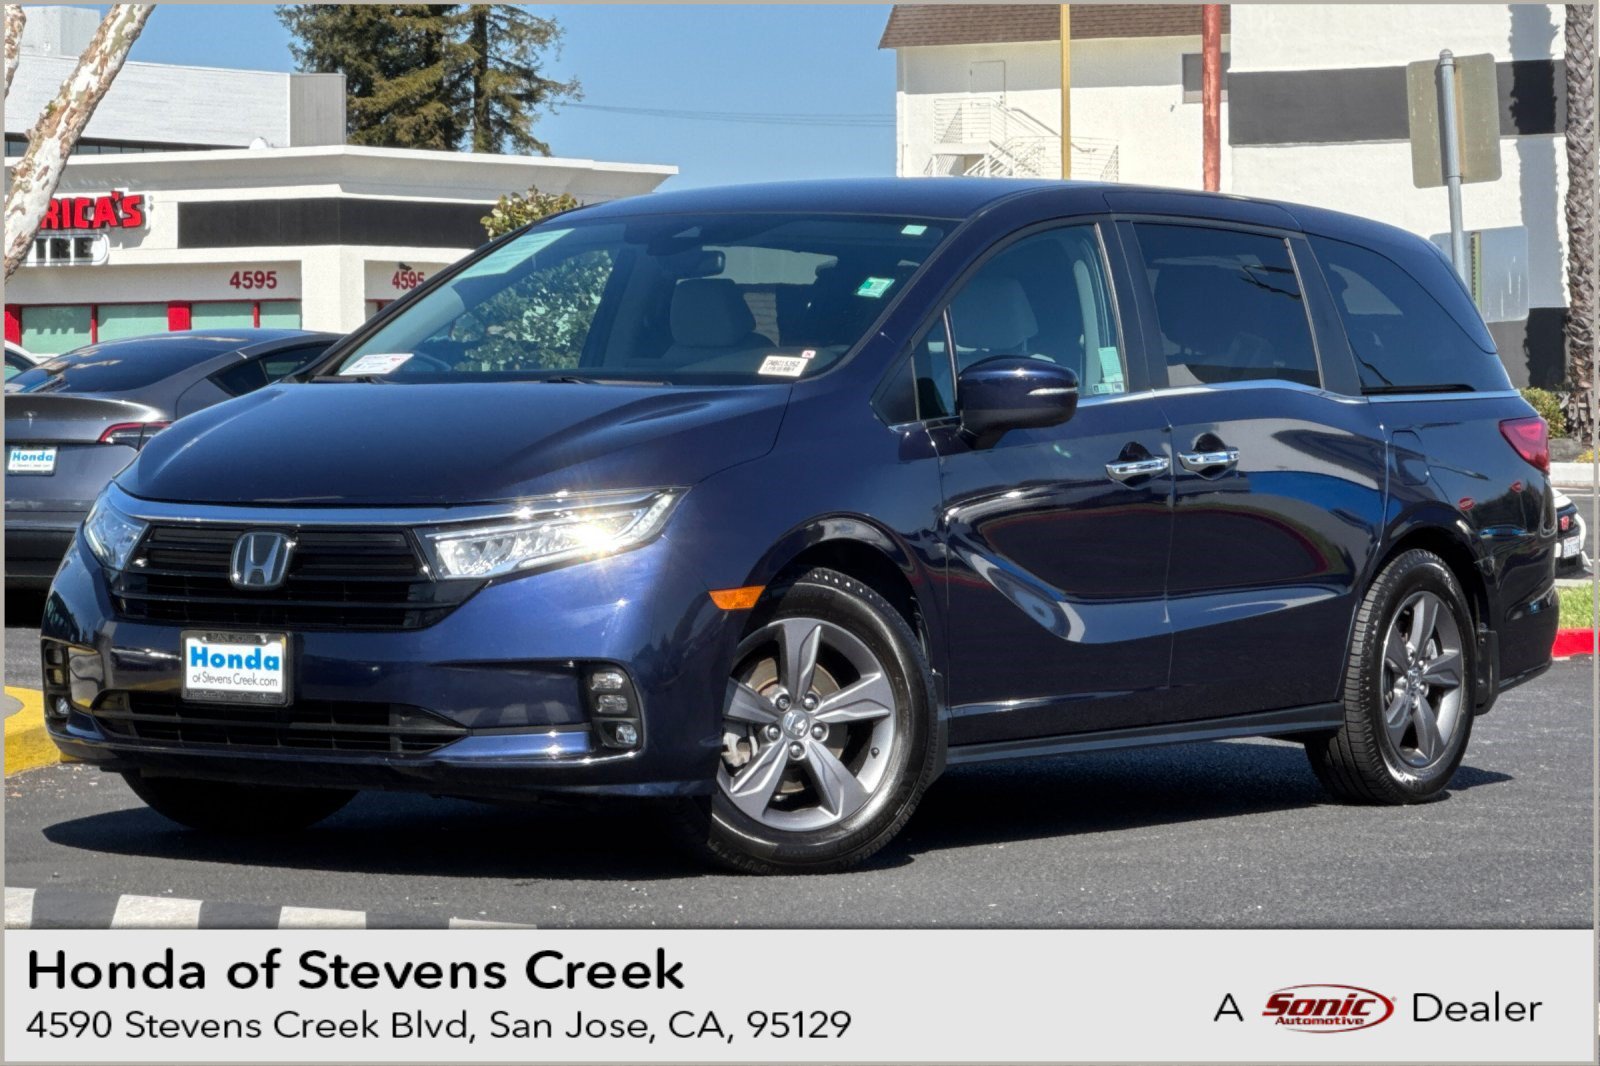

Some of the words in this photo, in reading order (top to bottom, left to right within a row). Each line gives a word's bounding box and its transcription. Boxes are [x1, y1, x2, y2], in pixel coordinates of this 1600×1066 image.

[229, 271, 278, 289] 4595
[12, 451, 54, 462] Honda
[190, 645, 280, 671] Honda
